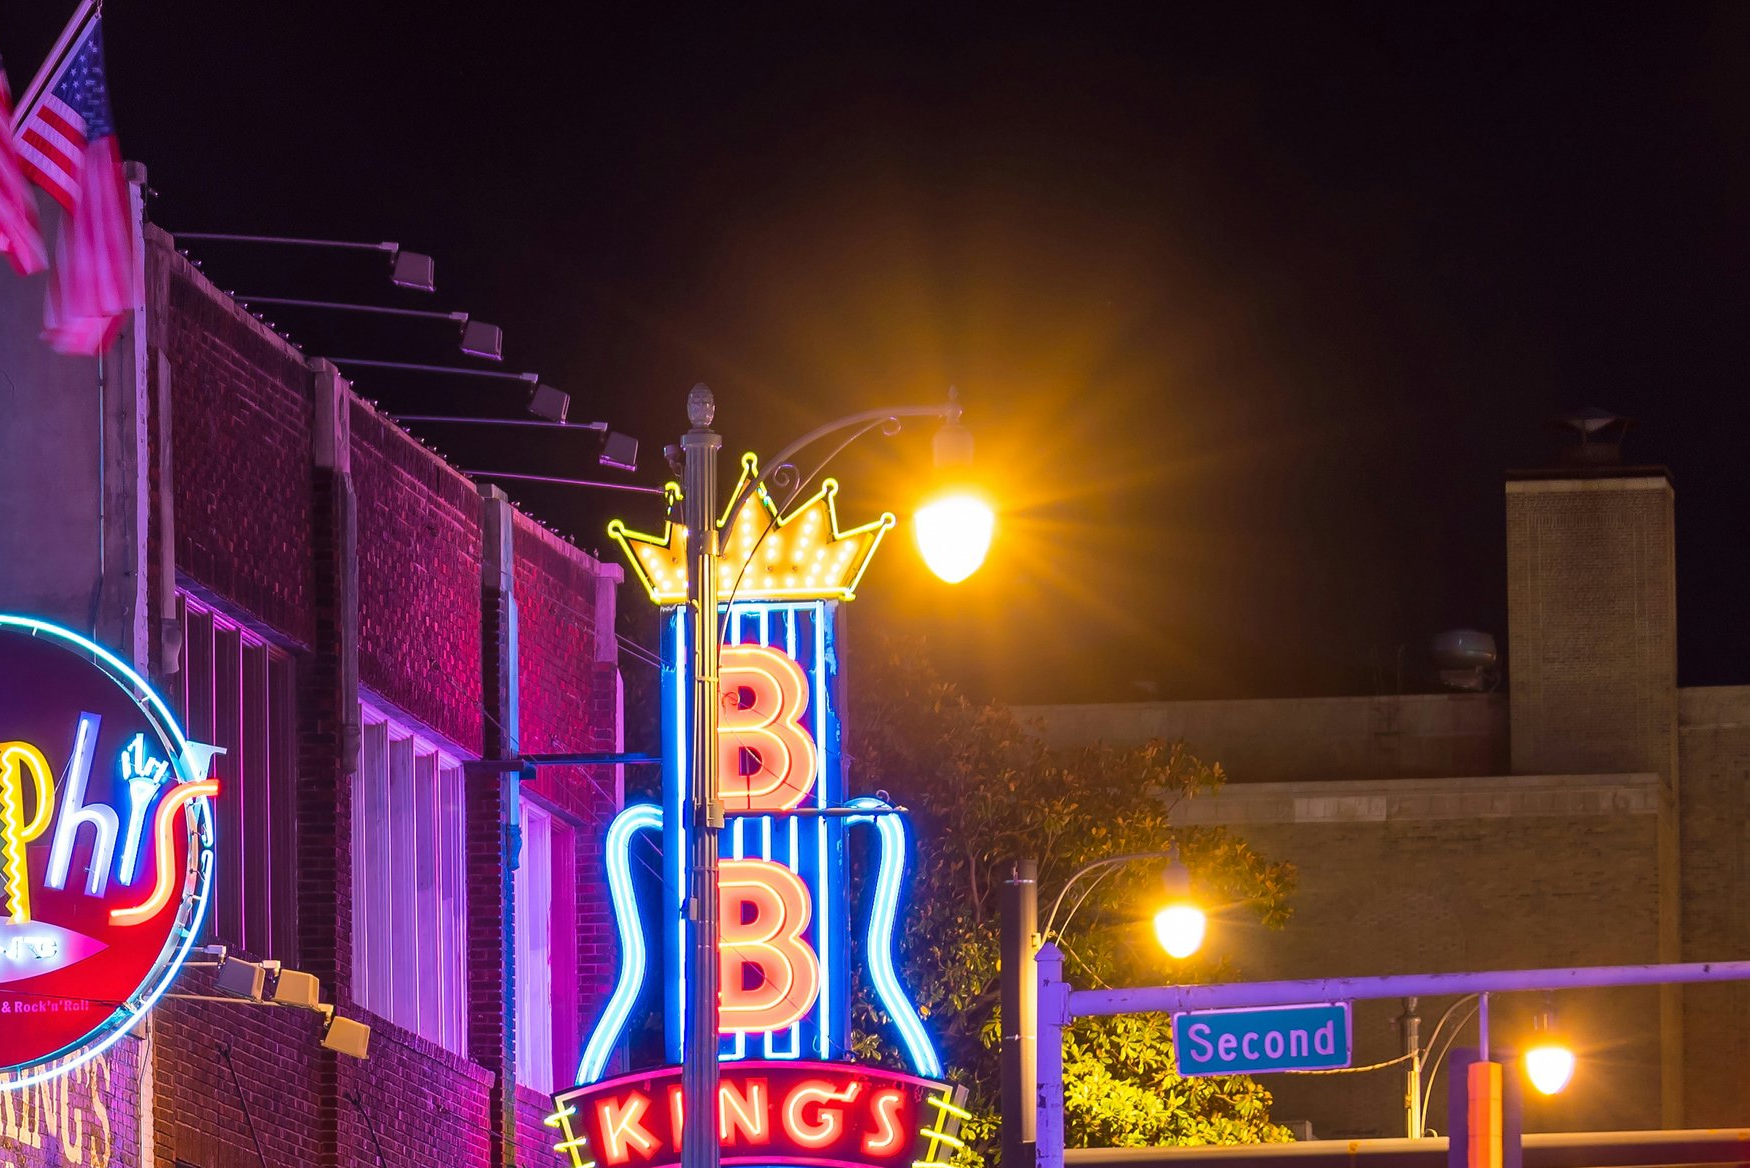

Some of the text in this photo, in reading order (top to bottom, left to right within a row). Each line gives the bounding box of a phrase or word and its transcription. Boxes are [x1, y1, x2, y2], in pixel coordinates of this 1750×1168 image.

[718, 643, 818, 811] B
[718, 858, 819, 1033] B
[2, 1001, 11, 1013] &
[1188, 1020, 1335, 1063] Second
